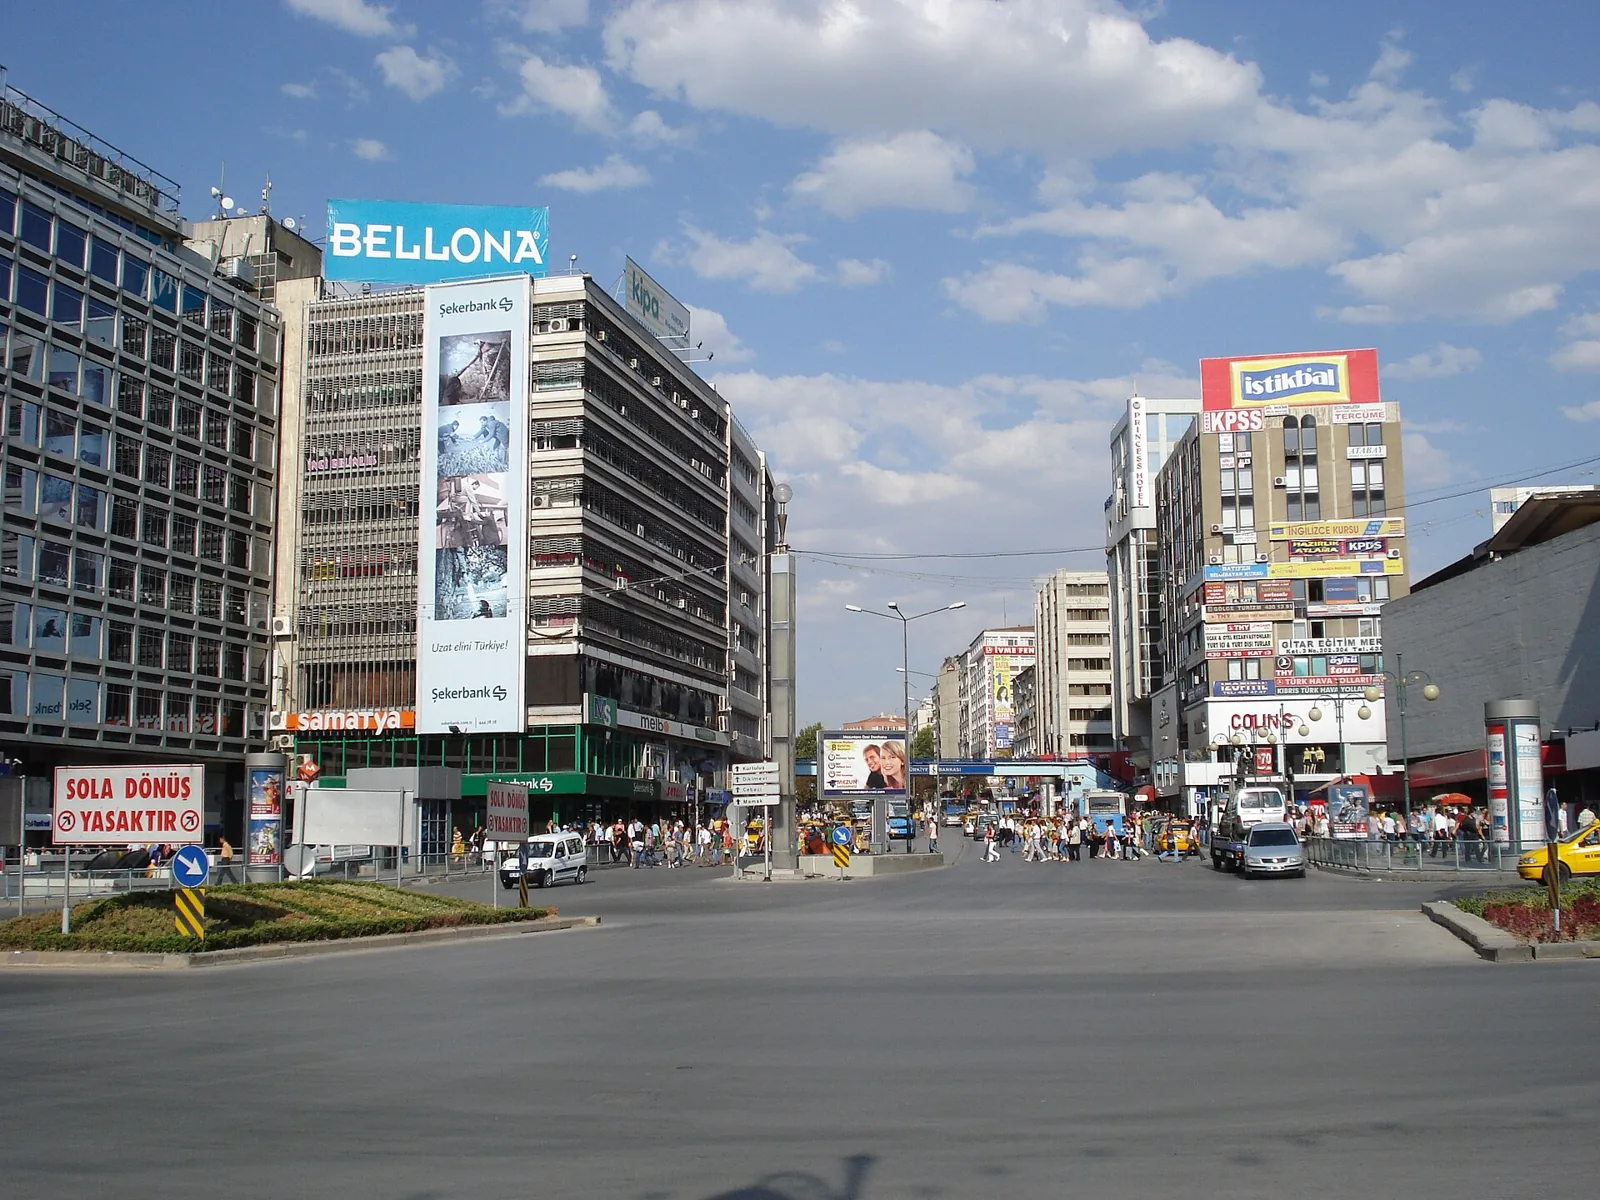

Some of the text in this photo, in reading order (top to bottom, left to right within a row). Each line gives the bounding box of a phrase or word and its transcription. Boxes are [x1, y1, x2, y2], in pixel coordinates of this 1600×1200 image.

[330, 223, 543, 264] BELLONA
[632, 270, 660, 320] kipa
[439, 299, 497, 318] Şekerbank
[1244, 367, 1336, 395] istikbal
[1211, 410, 1262, 431] KPSS
[1134, 412, 1144, 507] PRINCESS HOTEL
[1288, 525, 1359, 536] İNGİLİZCE KURSU
[432, 640, 508, 653] Uzat elini Türkiye!
[1281, 639, 1314, 648] GİTAR
[1318, 638, 1356, 648] EĞİTİM
[1329, 655, 1359, 665] öykü
[1329, 666, 1358, 674] tour
[1285, 677, 1308, 685] TÜRK
[1301, 685, 1319, 693] TÜRK
[432, 686, 491, 703] Şekerbank
[66, 772, 191, 801] SOLA DÖNÜŞ
[490, 789, 526, 811] SOLA DÖNÜŞ
[80, 810, 177, 832] YASAKTIR
[493, 814, 522, 833] YASAKTIR
